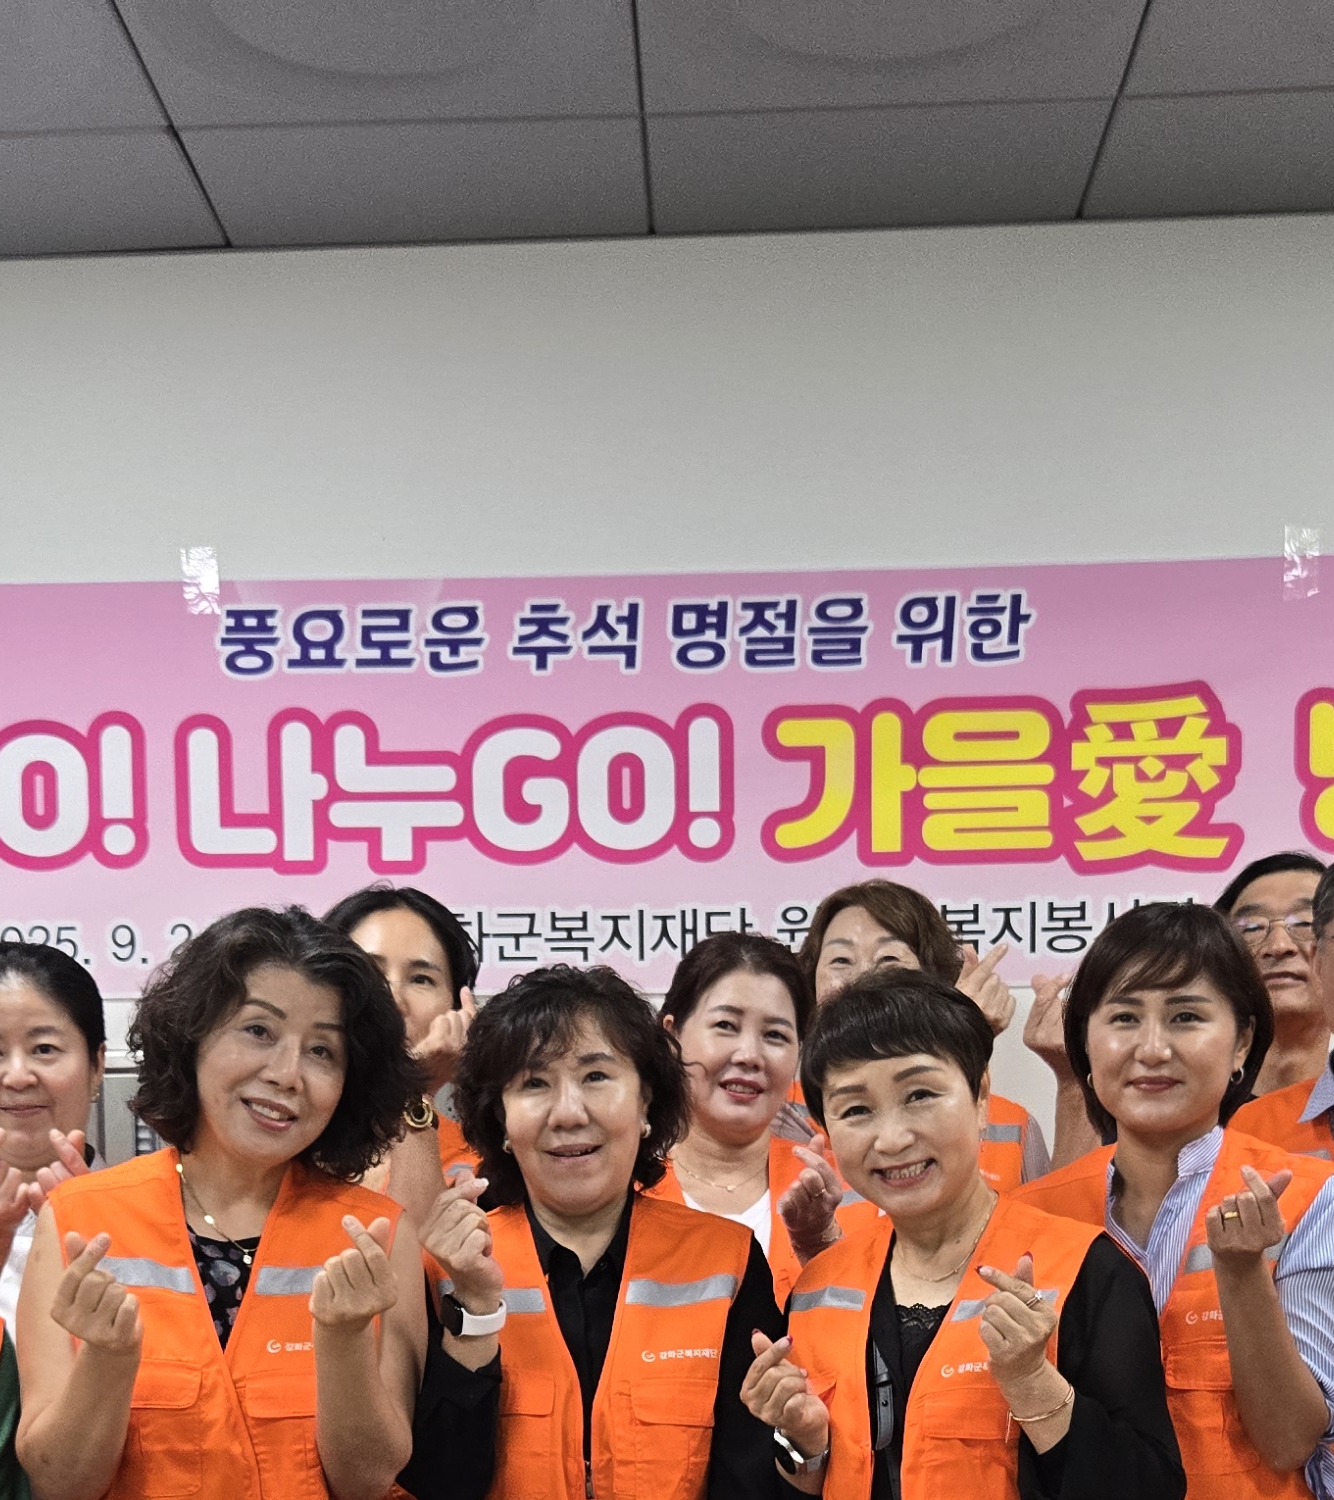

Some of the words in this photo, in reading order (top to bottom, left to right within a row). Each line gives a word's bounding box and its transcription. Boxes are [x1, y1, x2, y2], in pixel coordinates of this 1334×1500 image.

[221, 605, 485, 674] 풍요로운
[513, 601, 638, 670] 추석
[670, 597, 869, 668] 명절을
[896, 593, 1030, 664] 위한
[182, 709, 728, 869] 나누GO!
[768, 688, 1236, 869] 가을愛
[110, 923, 149, 965] 9.
